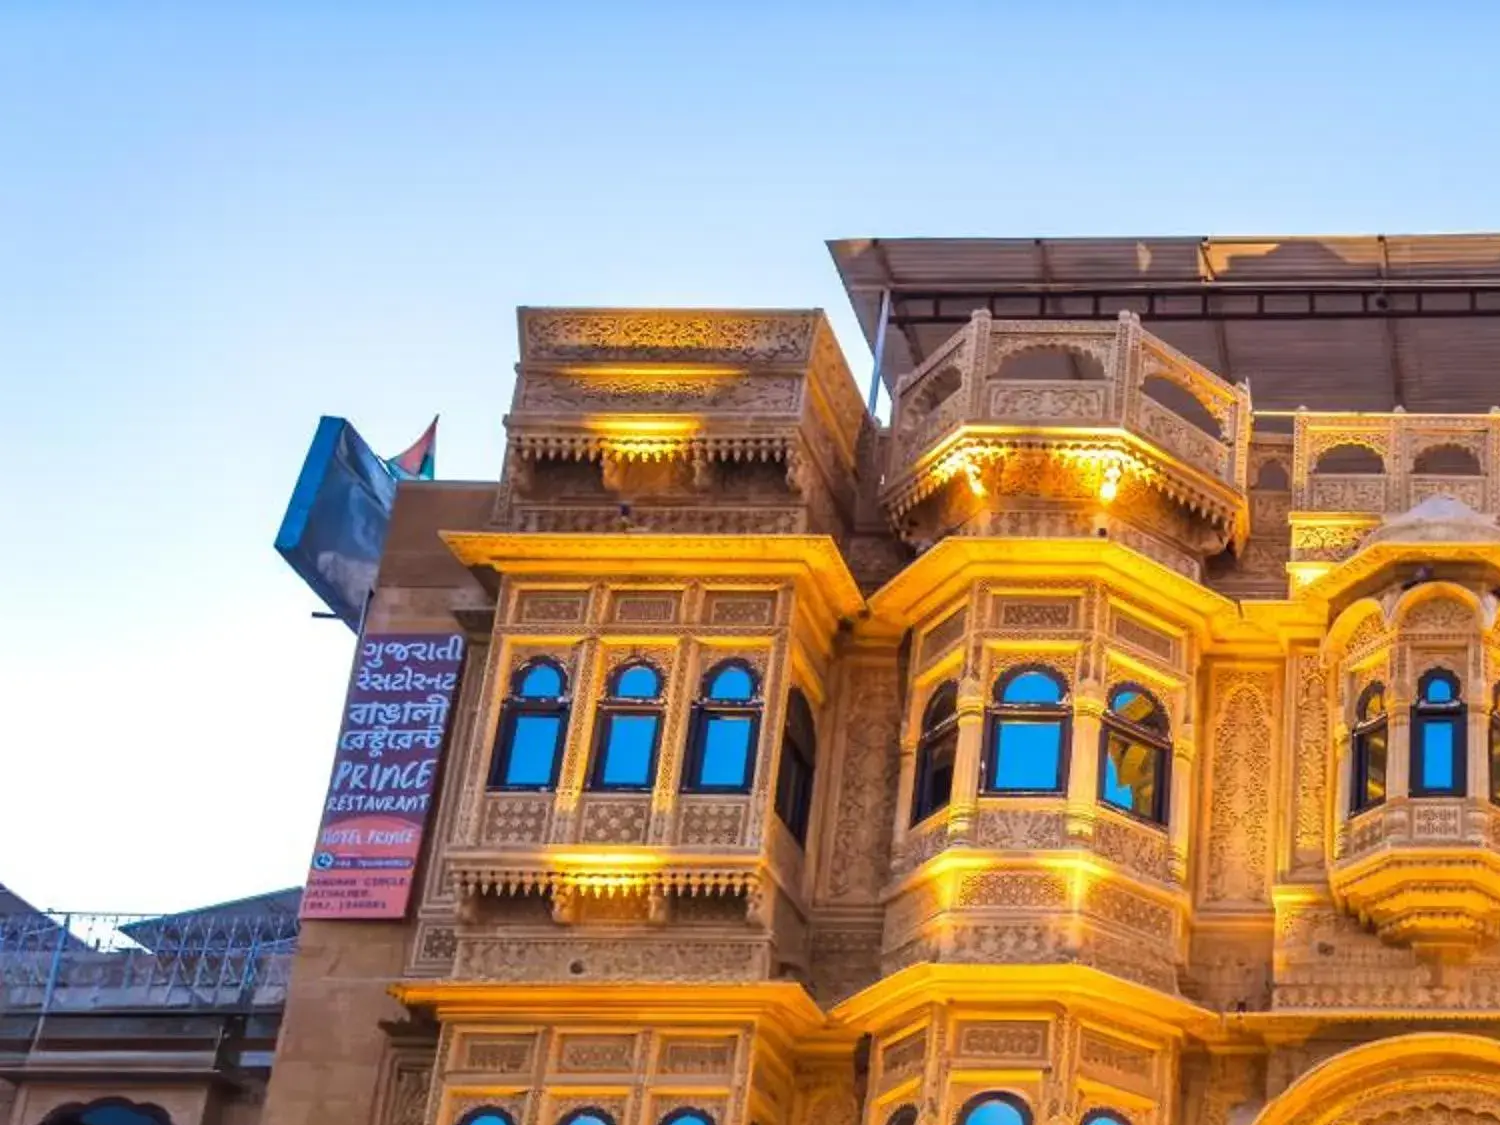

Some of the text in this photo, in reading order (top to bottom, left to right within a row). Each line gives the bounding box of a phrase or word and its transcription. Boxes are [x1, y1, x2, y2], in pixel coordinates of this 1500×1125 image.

[363, 634, 463, 668] ગુજરાતી
[333, 760, 437, 791] PRINCE
[327, 793, 431, 813] RESTAURANT
[320, 828, 415, 845] HOTEL PRINCE
